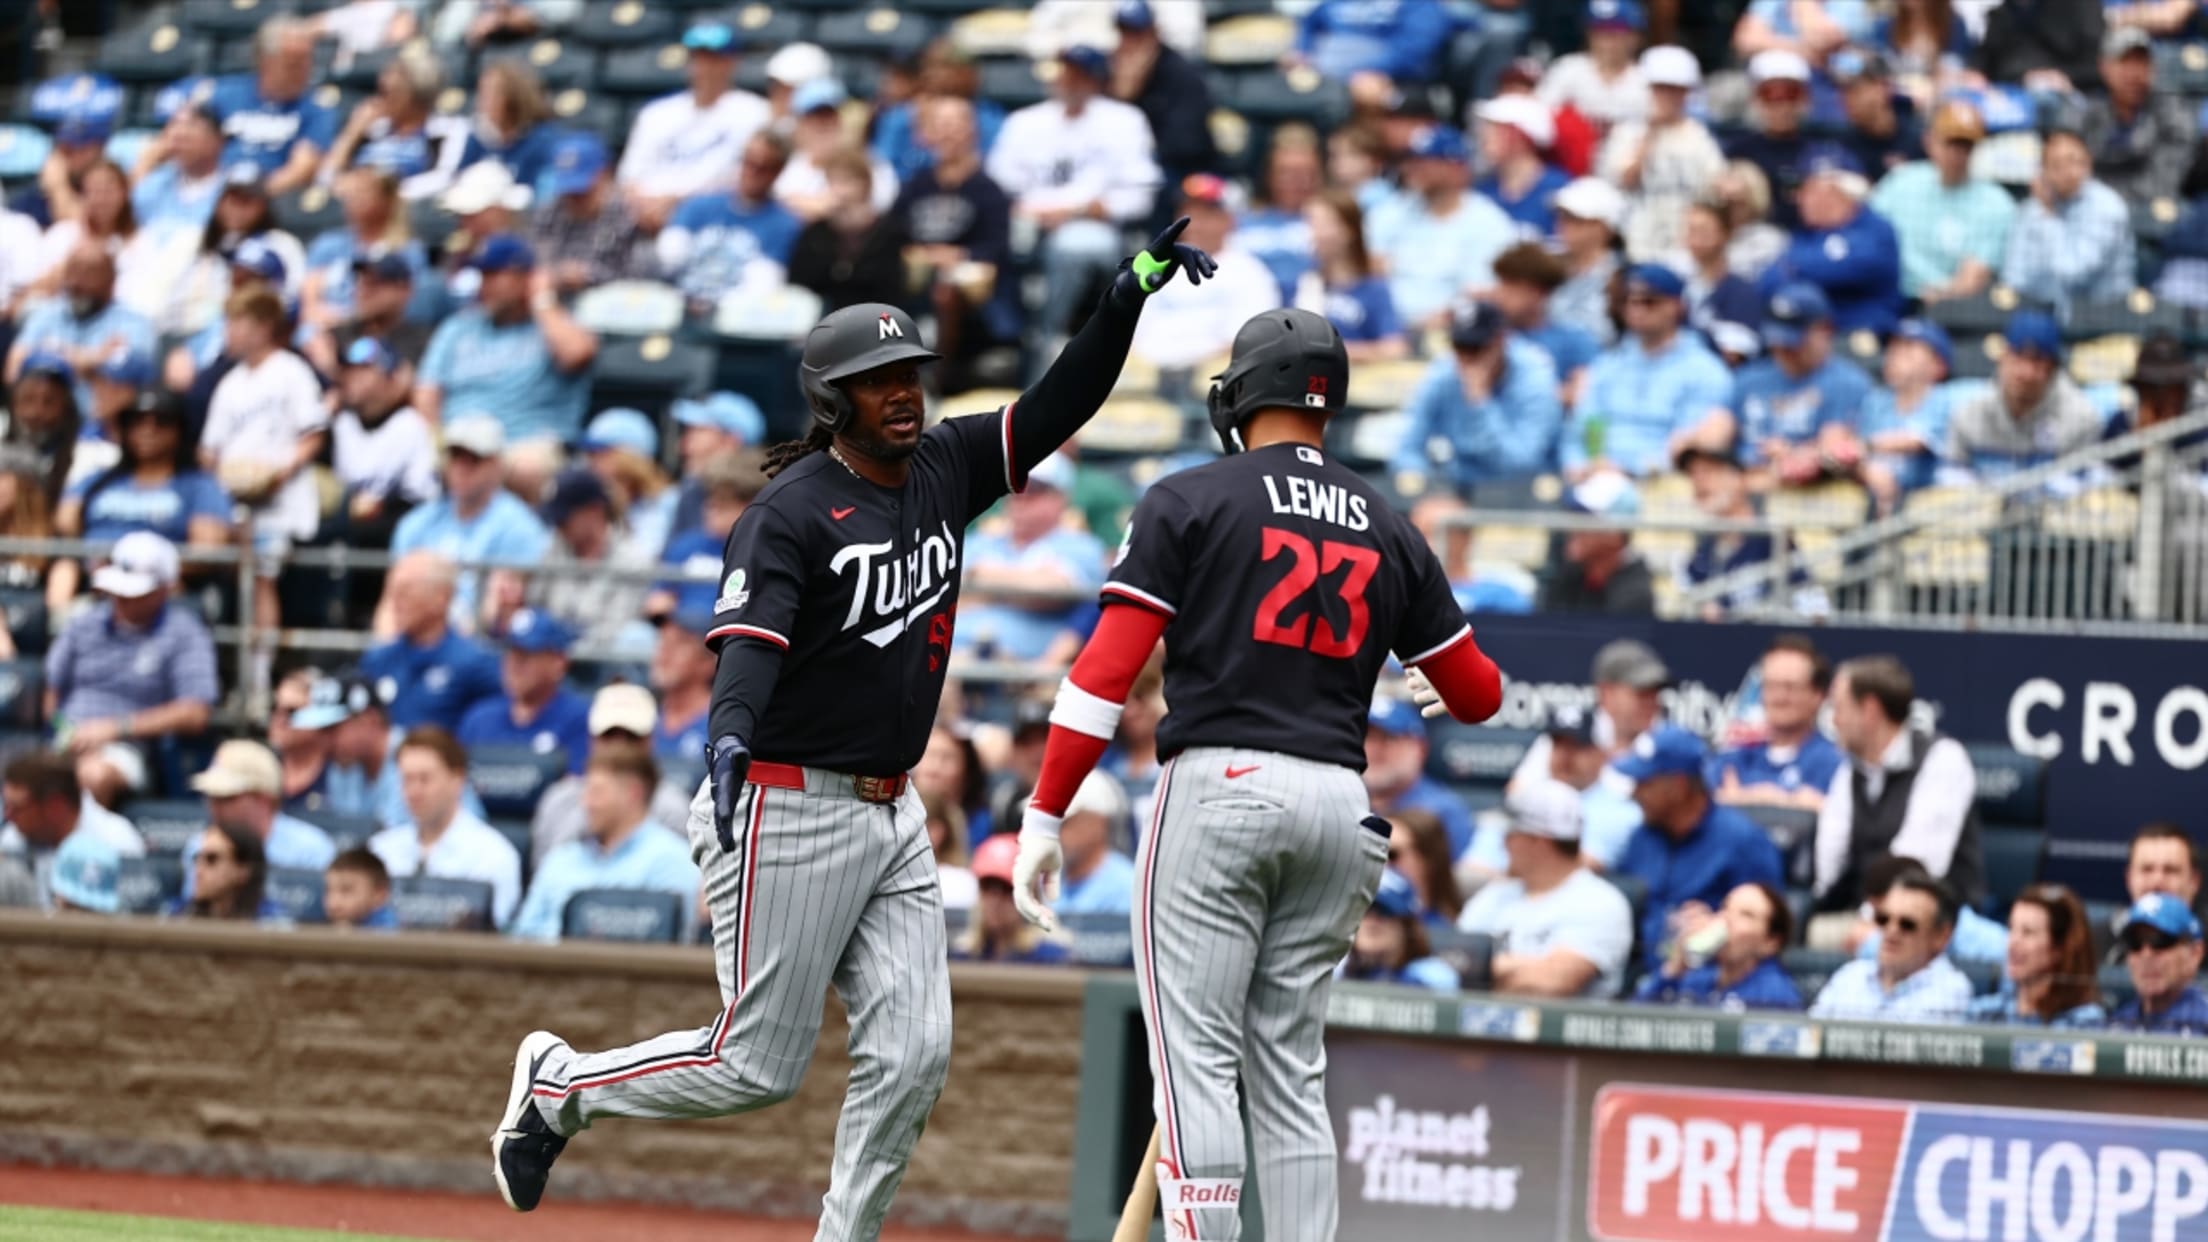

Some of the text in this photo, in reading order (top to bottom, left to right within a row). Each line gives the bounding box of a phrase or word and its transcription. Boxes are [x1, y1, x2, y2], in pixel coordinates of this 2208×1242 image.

[879, 316, 904, 340] M
[1308, 375, 1328, 393] 23
[1262, 475, 1369, 531] LEWIS
[829, 520, 956, 648] Twins
[1253, 526, 1381, 658] 23
[2007, 677, 2208, 769] CRO
[1346, 1094, 1489, 1163] planet
[1179, 1184, 1240, 1203] Rolls
[1362, 1150, 1516, 1211] fitness
[1622, 1113, 2208, 1242] PRICE CHOPP
